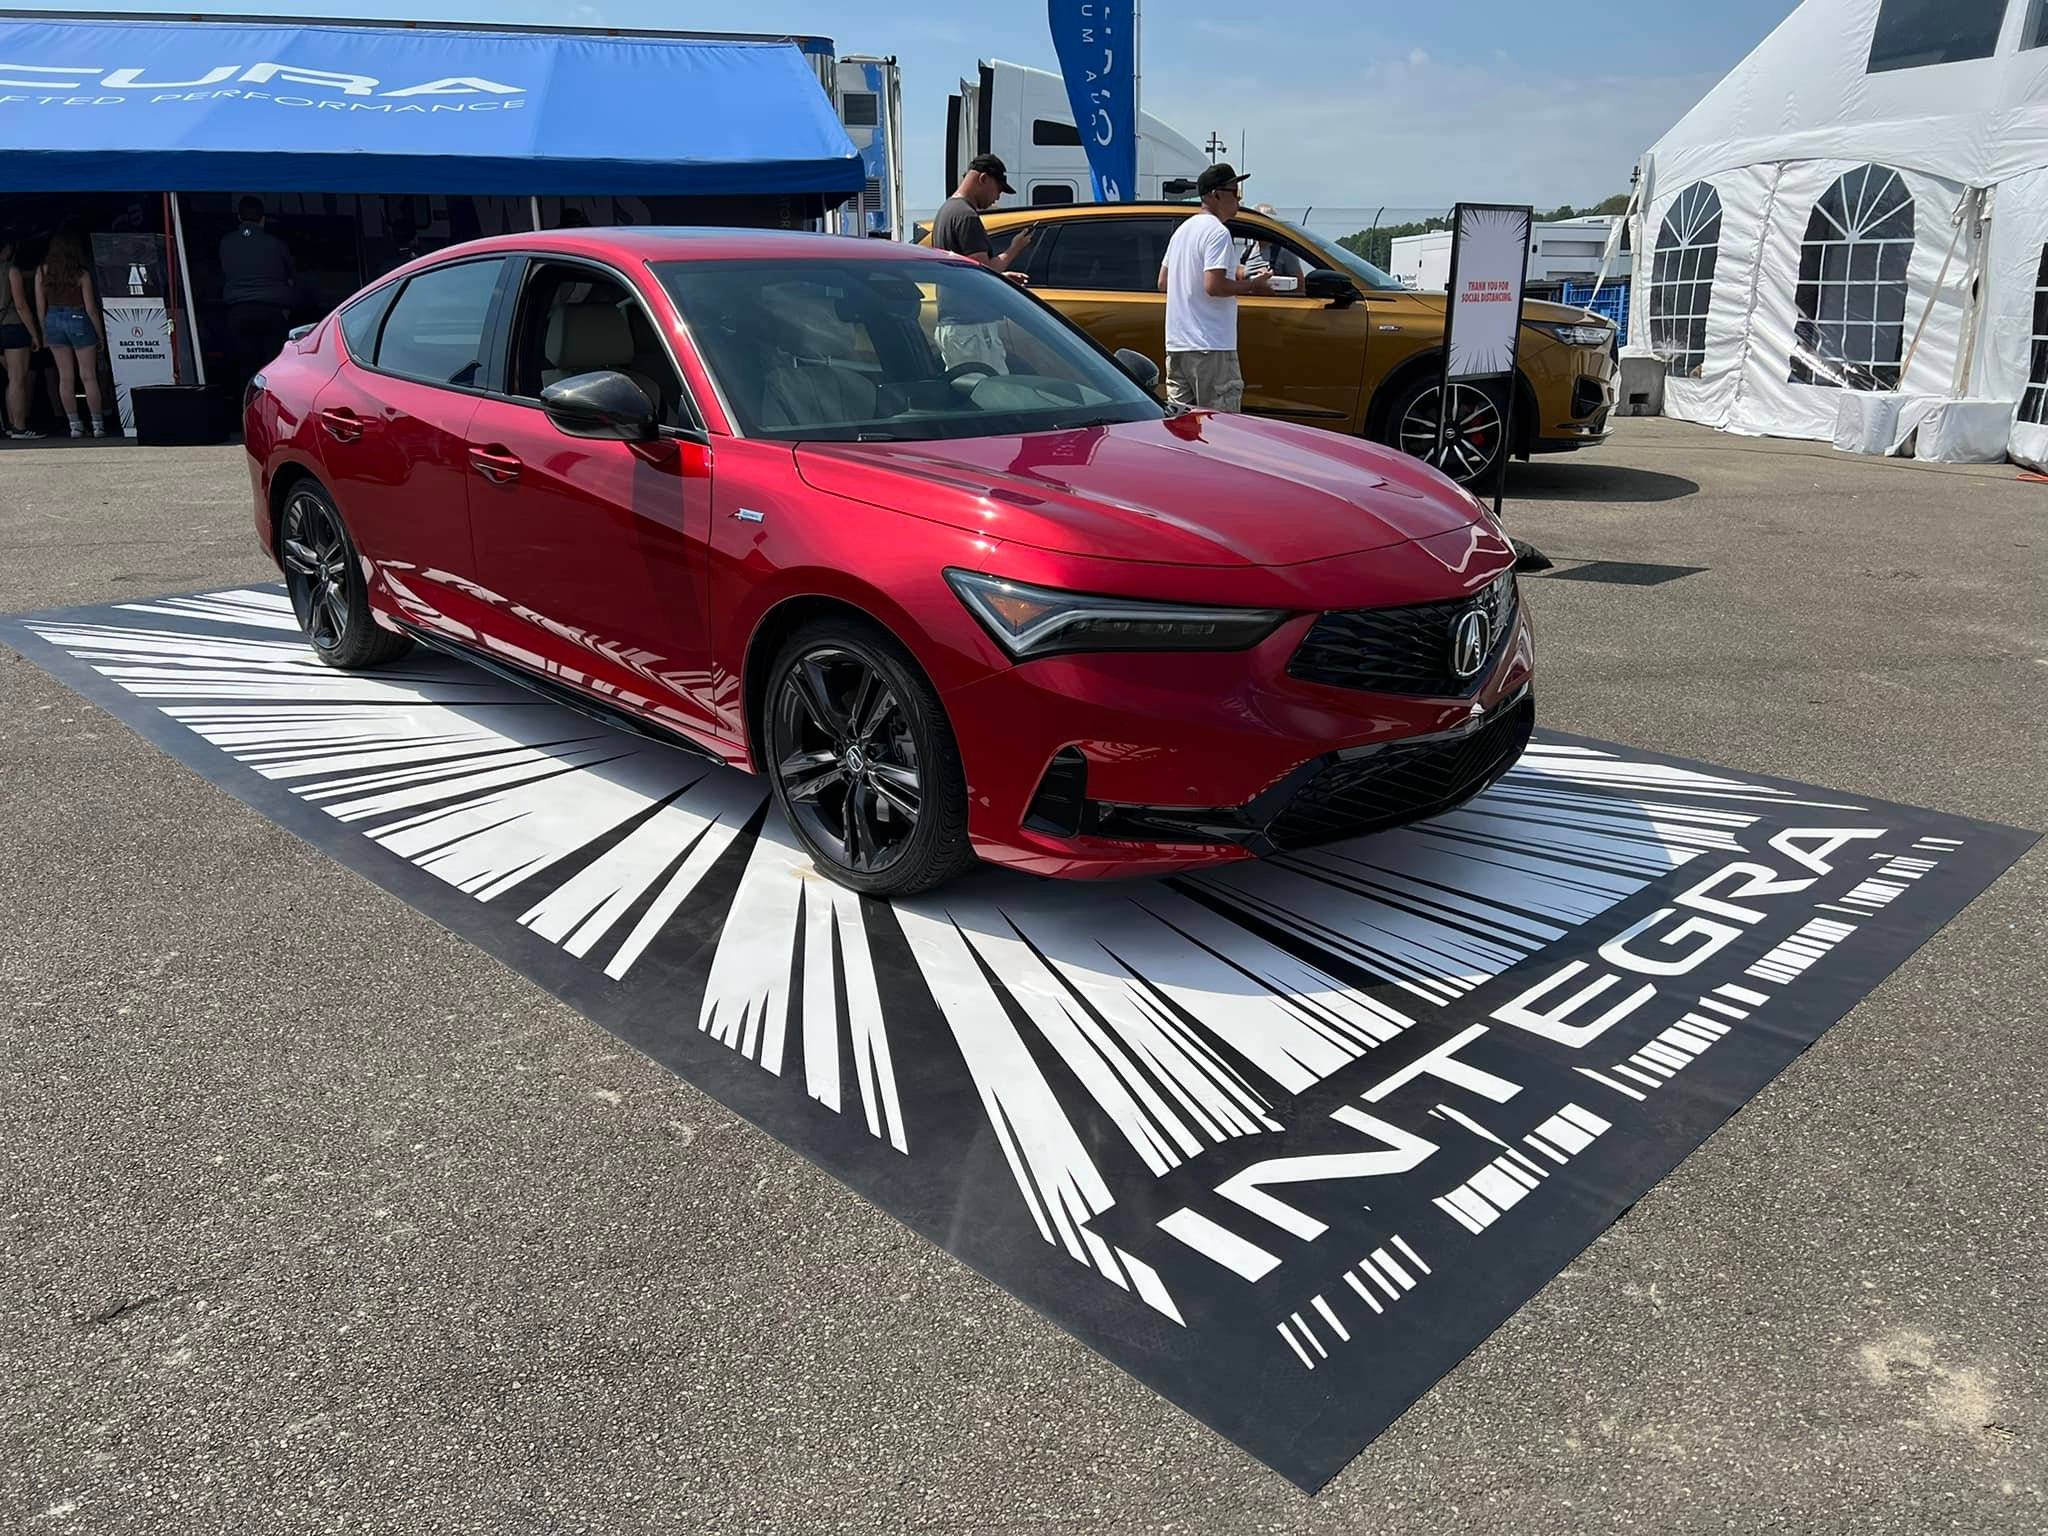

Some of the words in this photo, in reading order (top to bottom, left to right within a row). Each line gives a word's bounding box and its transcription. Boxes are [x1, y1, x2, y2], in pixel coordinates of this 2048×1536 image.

[151, 89, 526, 113] PERFORMANCE
[1468, 281, 1486, 291] THANK
[1487, 281, 1498, 291] YOU
[1498, 281, 1510, 291] FOR
[1461, 292, 1480, 303] SOCIAL
[1157, 826, 1888, 1284] INTEGRA
